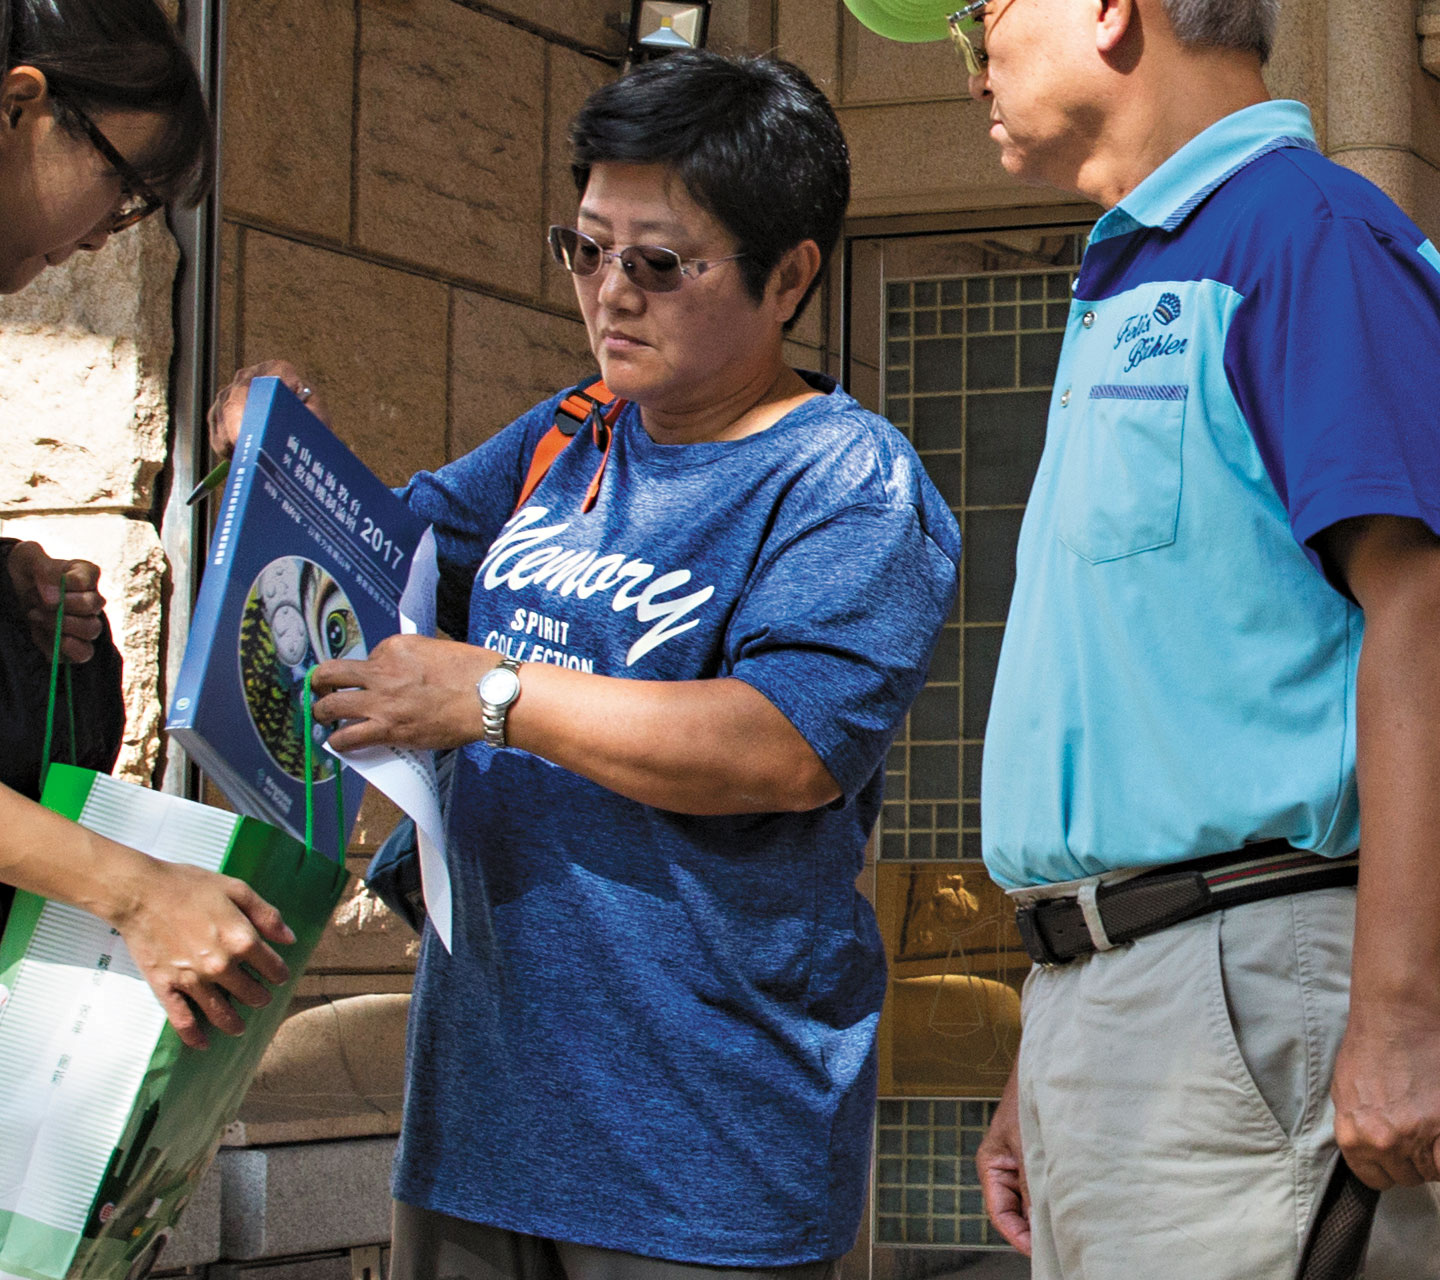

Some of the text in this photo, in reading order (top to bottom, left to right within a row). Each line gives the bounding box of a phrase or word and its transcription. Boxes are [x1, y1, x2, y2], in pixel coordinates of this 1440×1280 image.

[360, 516, 404, 570] 2017
[474, 506, 715, 667] Memory
[510, 608, 570, 646] SPIRIT
